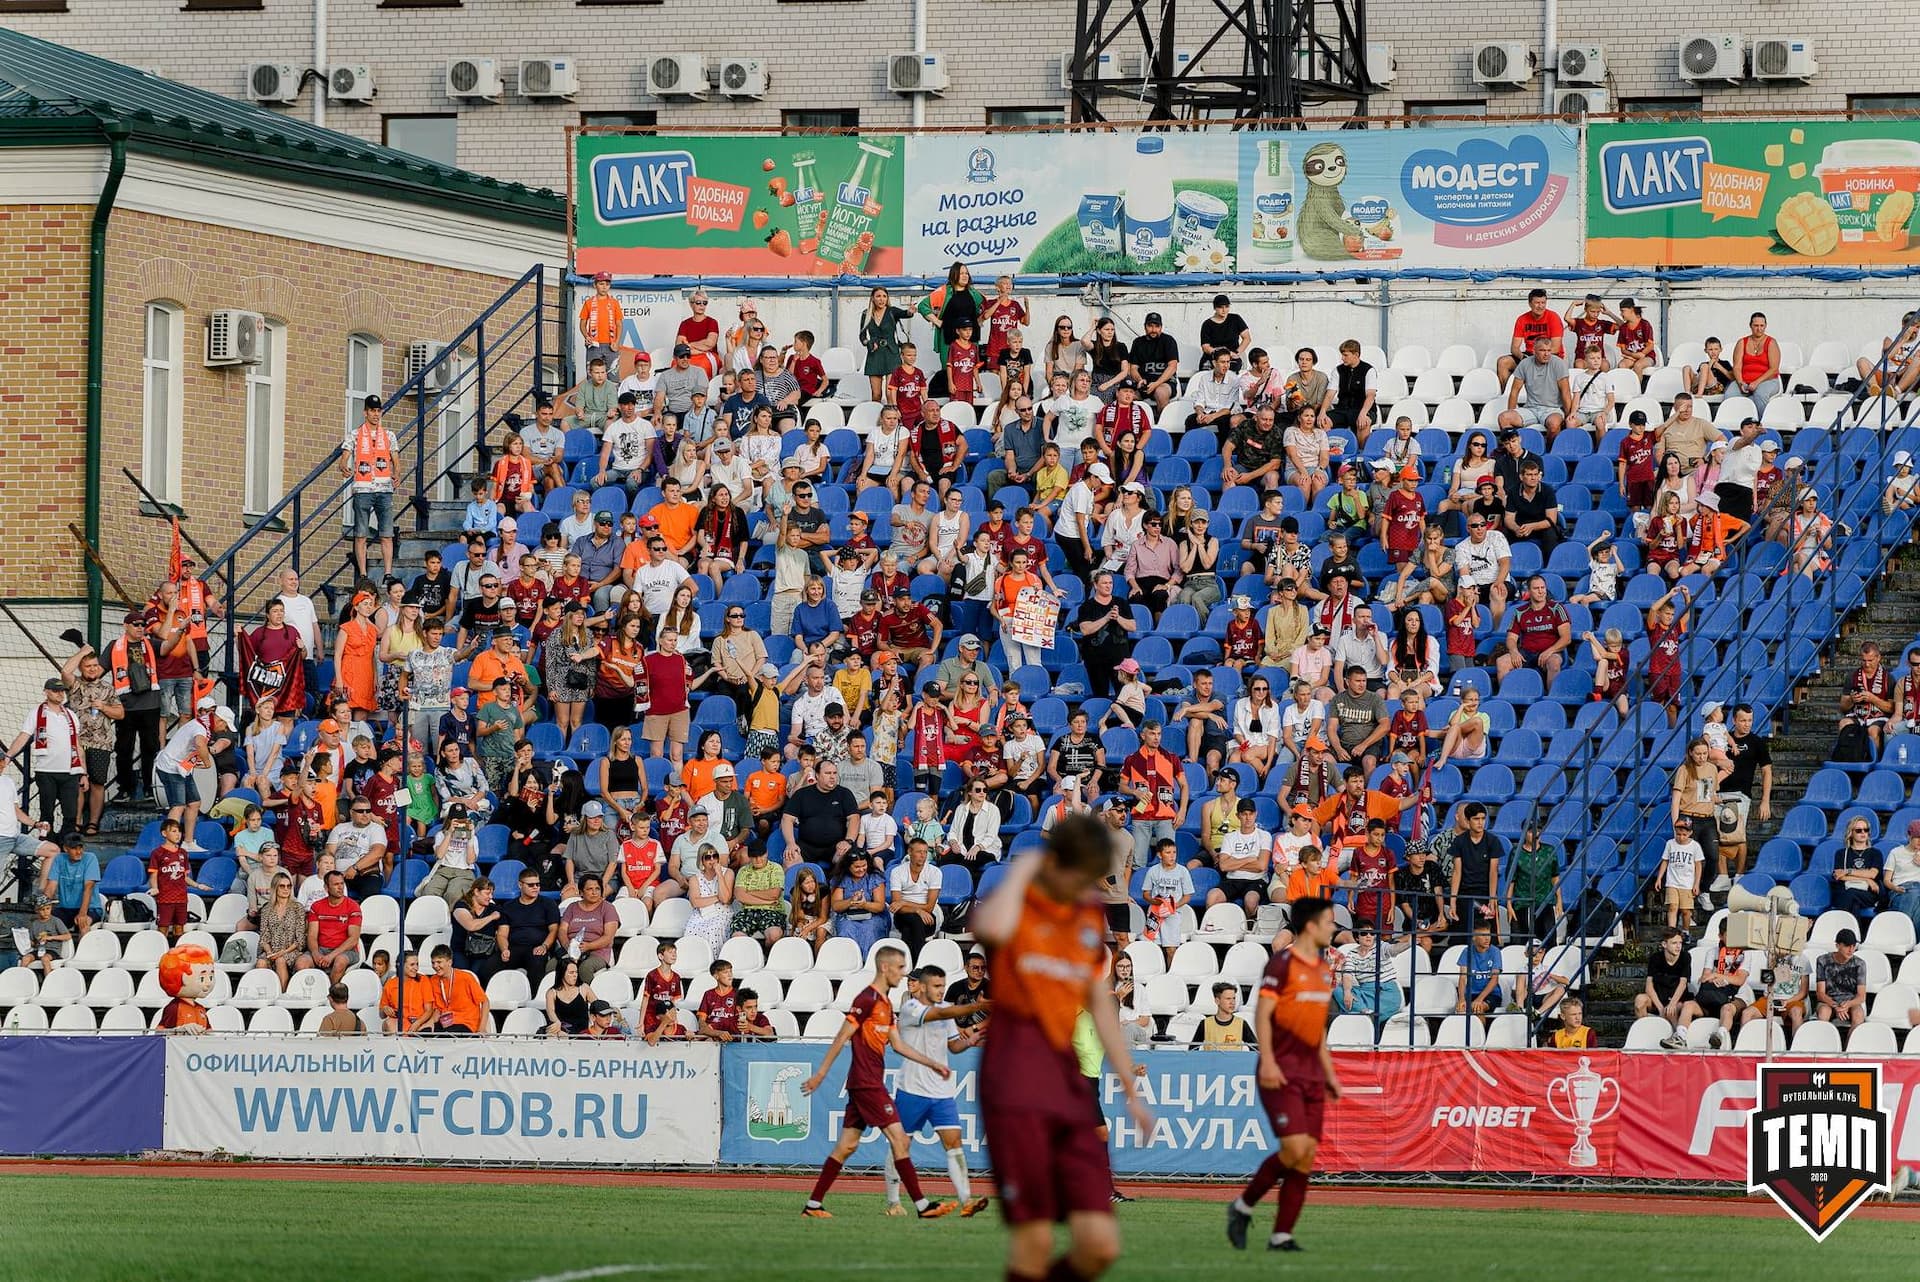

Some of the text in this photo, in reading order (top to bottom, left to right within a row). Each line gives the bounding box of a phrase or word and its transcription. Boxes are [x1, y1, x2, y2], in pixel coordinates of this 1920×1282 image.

[1411, 162, 1539, 191] МОДЕСТ
[1616, 147, 1705, 199] ЛАКТ
[1709, 171, 1764, 193] УДОБНАЯ
[606, 161, 689, 211] ЛАКТ
[692, 185, 744, 206] УДОБНАЯ
[1845, 178, 1895, 191] НОВИНКА
[938, 188, 1025, 212] Молоко
[1258, 198, 1291, 207] МОДЕСТ
[1434, 194, 1473, 202] эксперты
[1481, 192, 1514, 201] детском
[1436, 200, 1512, 210] молочном питании
[1706, 191, 1752, 210] ПОЛЬЗА
[691, 205, 734, 223] ПОЛЬЗА
[831, 204, 872, 231] ЙОГУРТ
[1352, 206, 1387, 215] МОДЕСТ
[1465, 182, 1560, 243] и детских вопросах!
[922, 210, 1038, 238] на разные
[943, 236, 1019, 258] «хочу»
[626, 293, 676, 304] ТРИБУНА
[1669, 851, 1693, 865] HAVE
[186, 1048, 697, 1080] ОФИЦИАЛЬНЫЙ САЙТ «ДИНАМО-БАРНАУЛ»
[233, 1086, 648, 1140] WWW.FCDB.RU
[1431, 1105, 1537, 1128] FONBET
